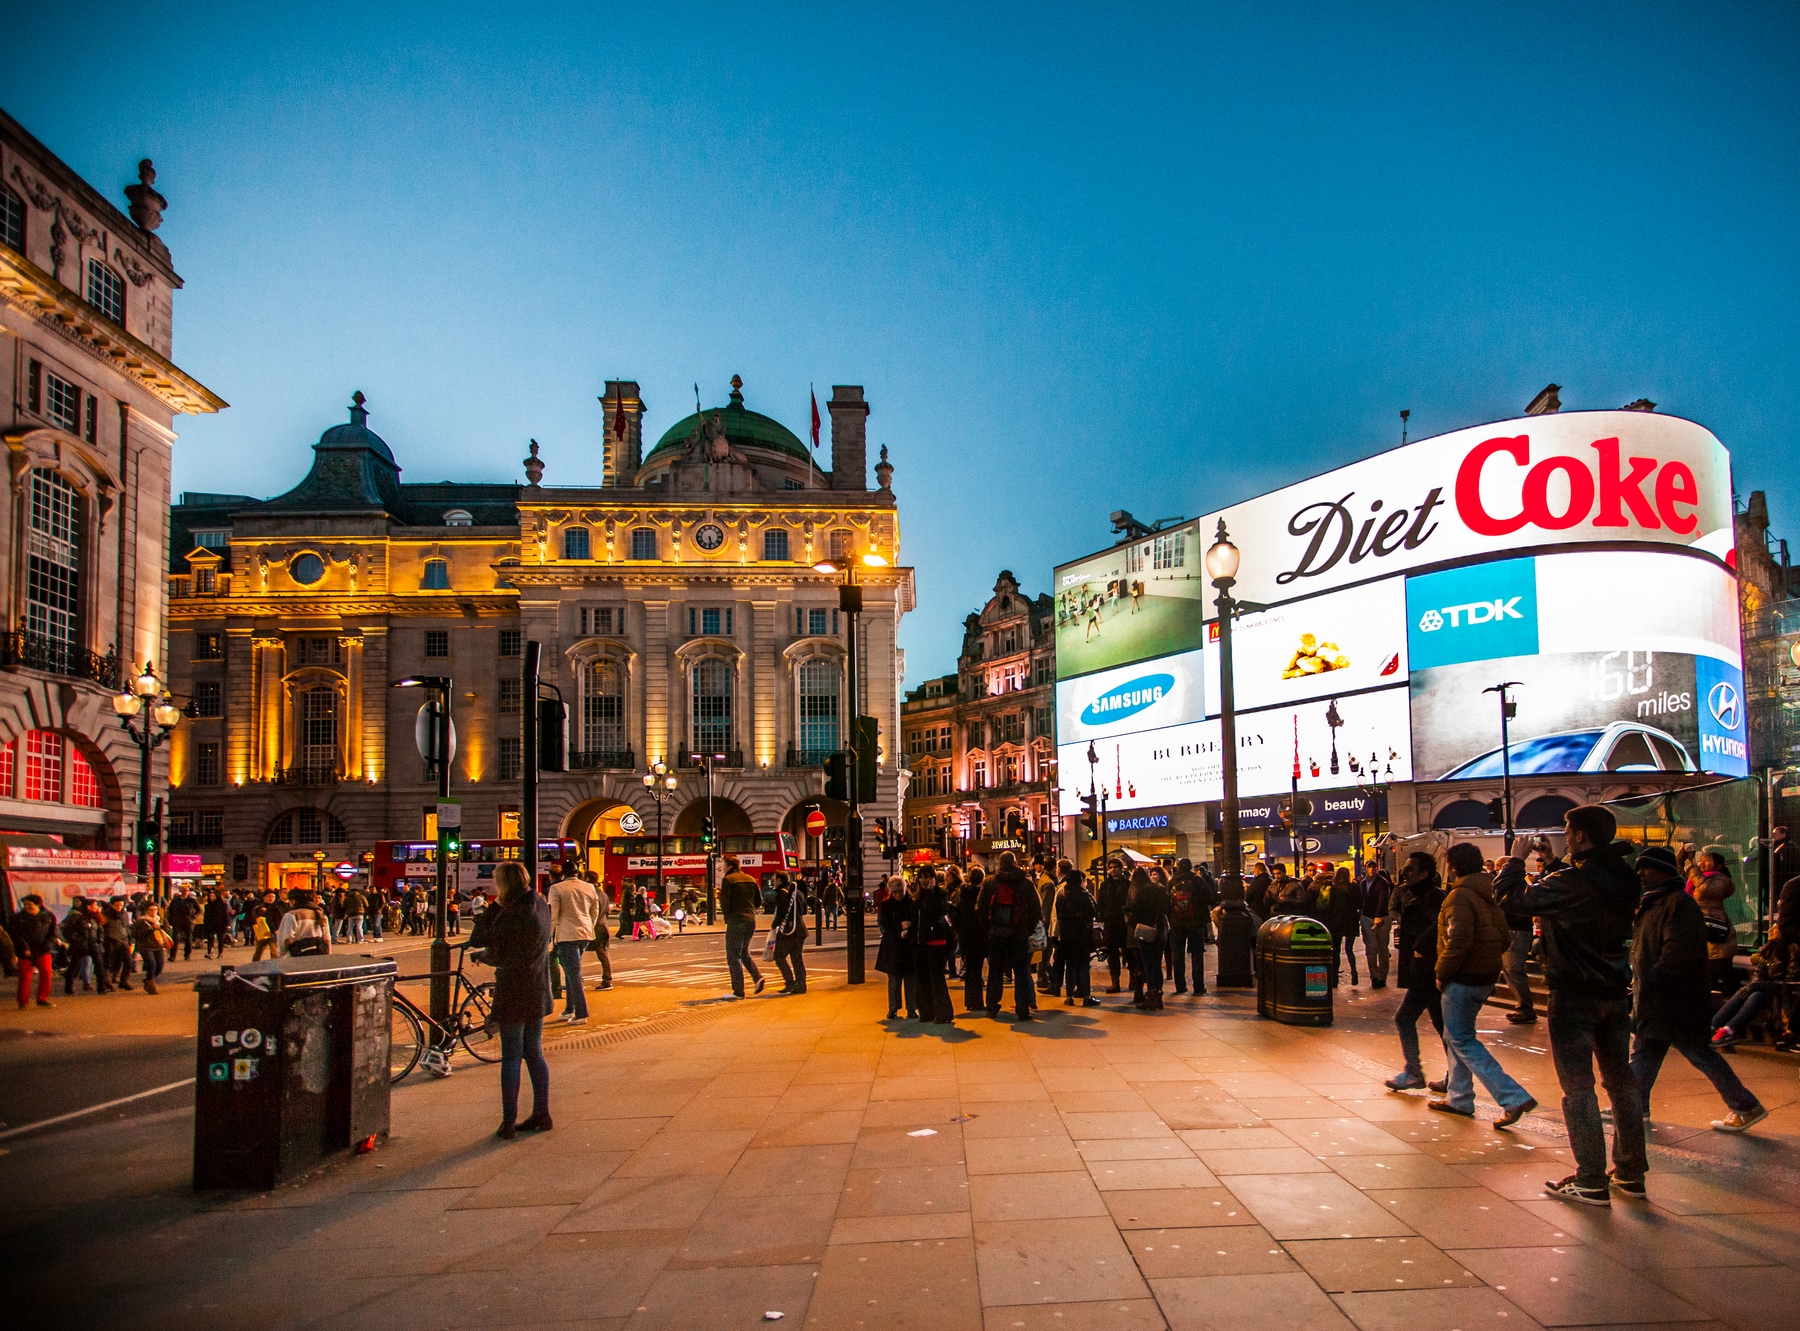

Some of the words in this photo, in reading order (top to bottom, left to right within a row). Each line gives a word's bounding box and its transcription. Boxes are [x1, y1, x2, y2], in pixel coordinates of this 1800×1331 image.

[1275, 486, 1445, 585] Diet
[1454, 434, 1699, 537] Coke
[1441, 596, 1524, 628] TDK
[1091, 685, 1163, 714] SAMSUNG
[1637, 690, 1692, 718] miles
[1153, 733, 1265, 760] BURBERY
[1702, 733, 1748, 761] HYUNDAI
[1219, 806, 1271, 821] prmacy
[1324, 797, 1365, 812] beauty
[1119, 815, 1168, 831] BARCLAYS
[677, 858, 707, 867] SHERMA
